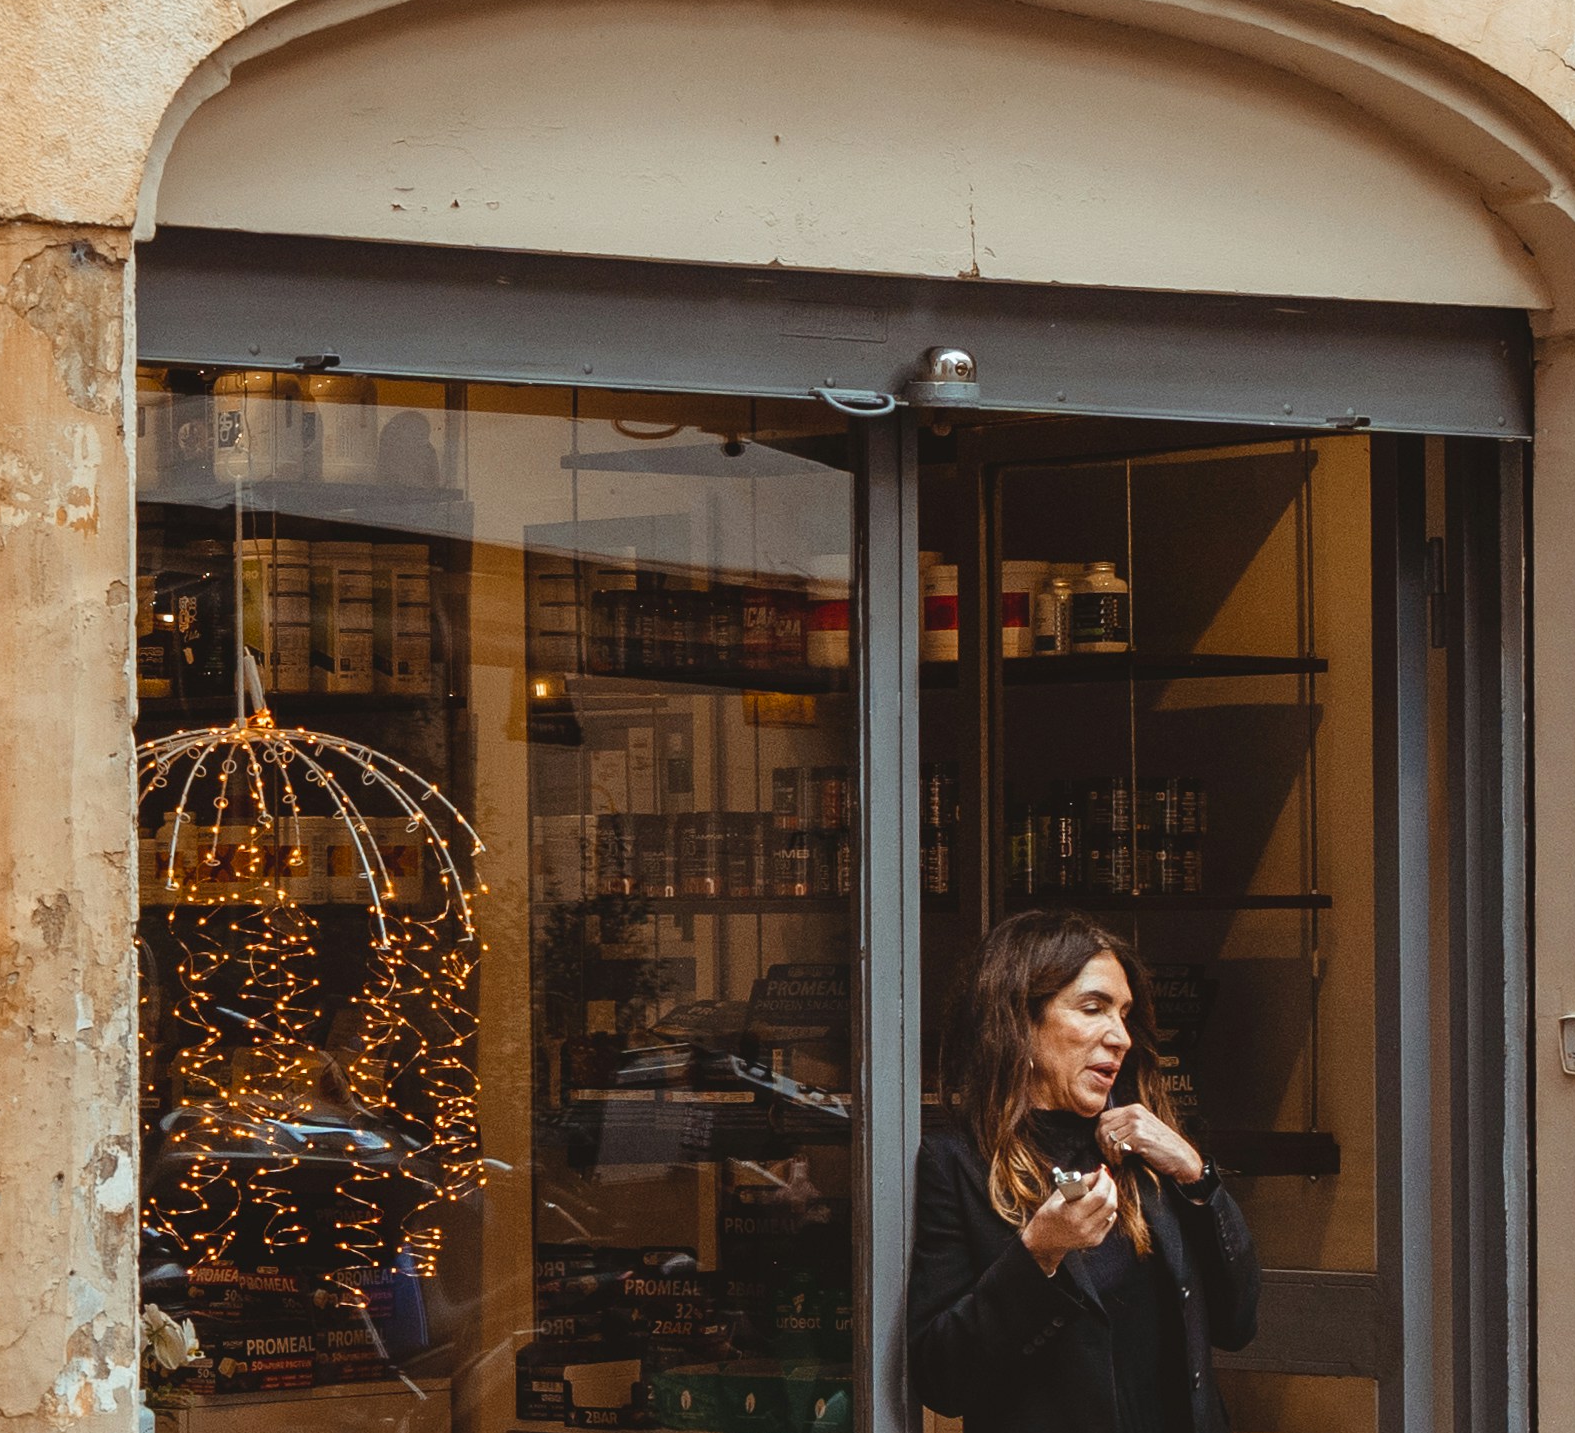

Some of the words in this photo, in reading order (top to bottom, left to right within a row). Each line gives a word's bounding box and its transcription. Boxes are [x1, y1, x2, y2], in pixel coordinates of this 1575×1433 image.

[767, 980, 847, 997] PROMEAL
[1154, 980, 1199, 998] MEAL
[1160, 1074, 1194, 1092] MEAL
[723, 1216, 801, 1235] PROMEAL
[189, 1266, 240, 1285] PROMEA
[239, 1275, 300, 1294] PROMEAL
[336, 1269, 395, 1288] PROMEAL
[624, 1279, 702, 1297] PROMEAL
[651, 1320, 693, 1336] 2BAR
[246, 1336, 316, 1357] PROMEAL
[326, 1329, 387, 1348] PROMEL
[584, 1410, 618, 1425] 2BAR
